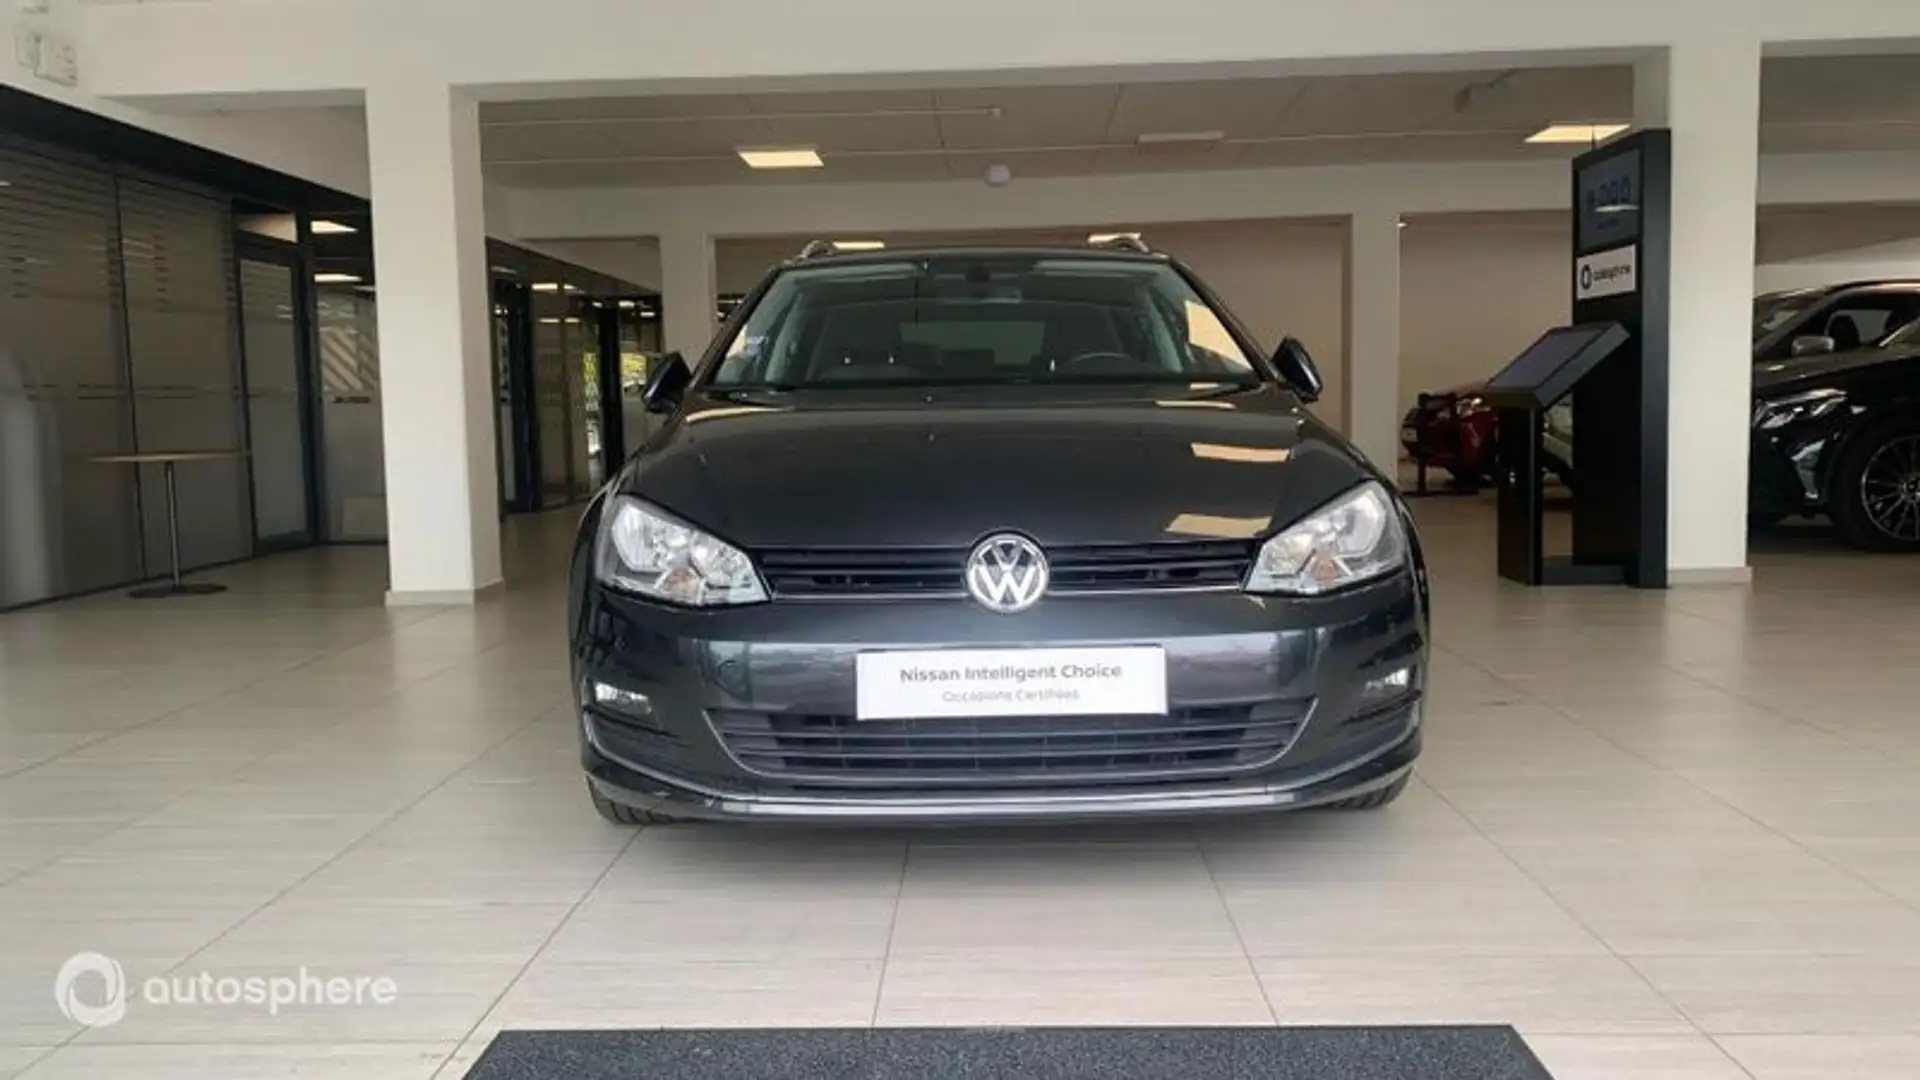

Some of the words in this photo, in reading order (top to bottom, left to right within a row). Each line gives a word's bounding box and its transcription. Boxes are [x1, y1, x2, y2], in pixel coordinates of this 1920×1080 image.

[969, 535, 1047, 612] VW
[900, 667, 960, 683] Nissan
[964, 665, 1057, 683] Intelligent
[1060, 663, 1122, 679] Choice
